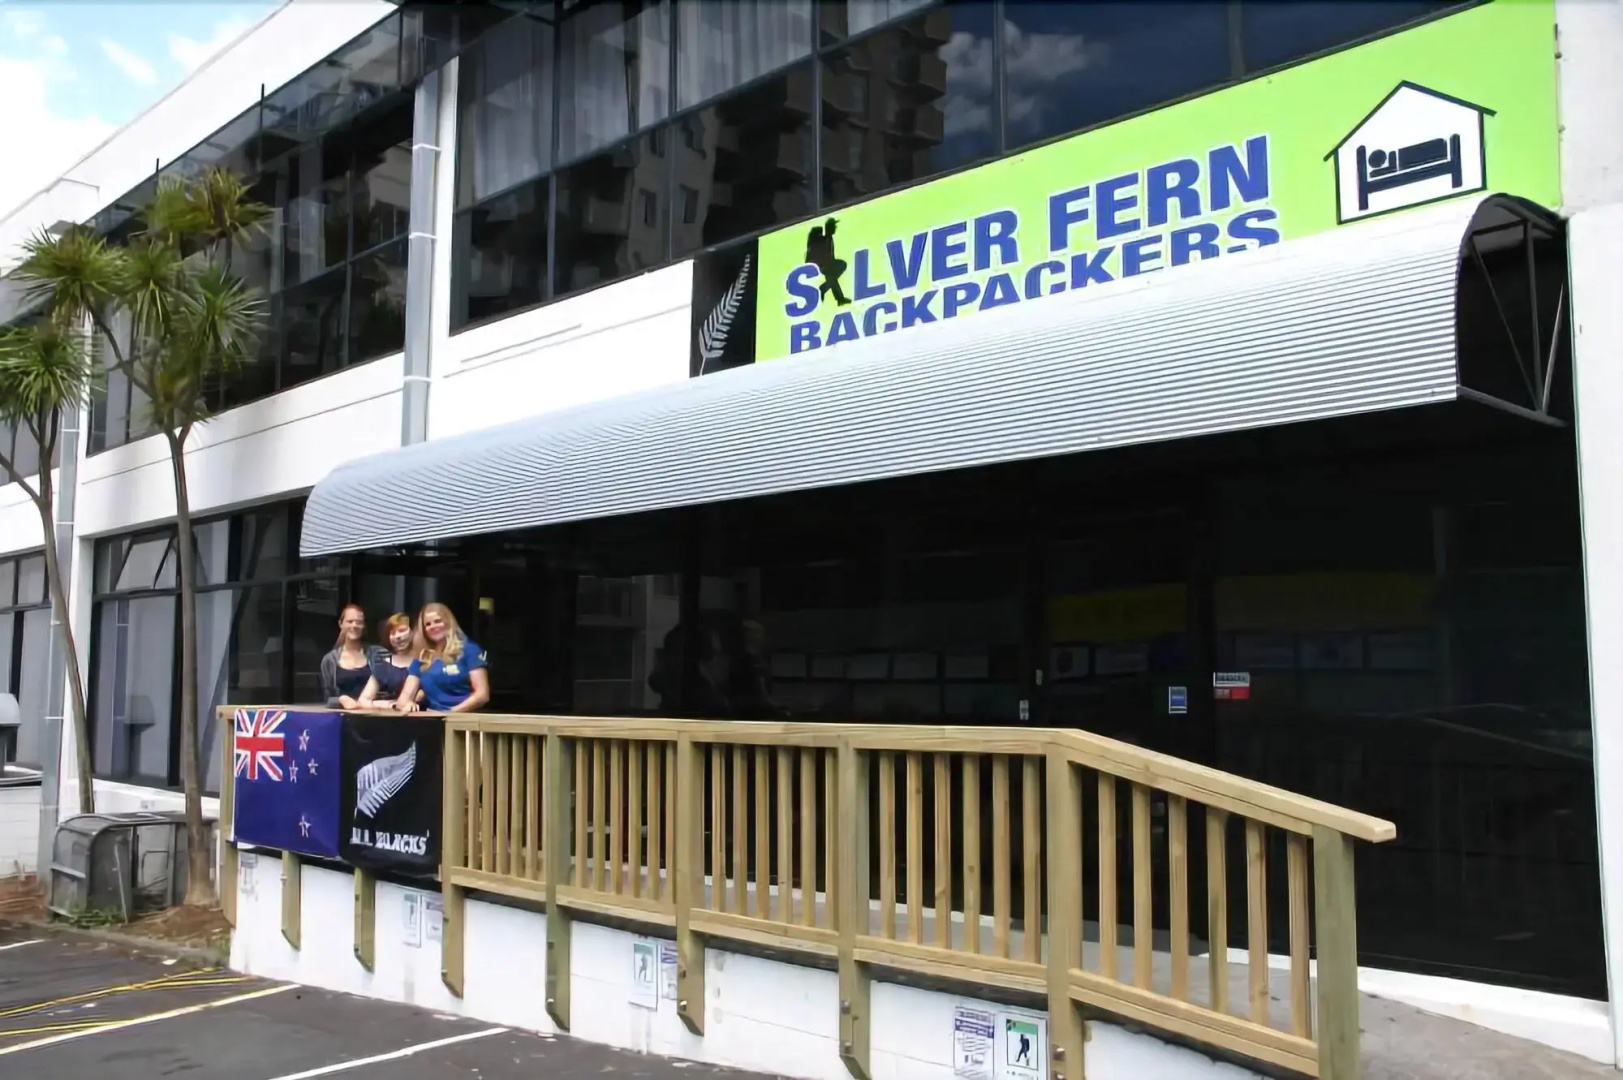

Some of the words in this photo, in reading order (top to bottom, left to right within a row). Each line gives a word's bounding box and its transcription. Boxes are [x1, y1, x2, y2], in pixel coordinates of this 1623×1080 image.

[785, 210, 1019, 317] SILVER
[1049, 135, 1269, 252] FERN
[790, 209, 1280, 355] BACKPACKERS
